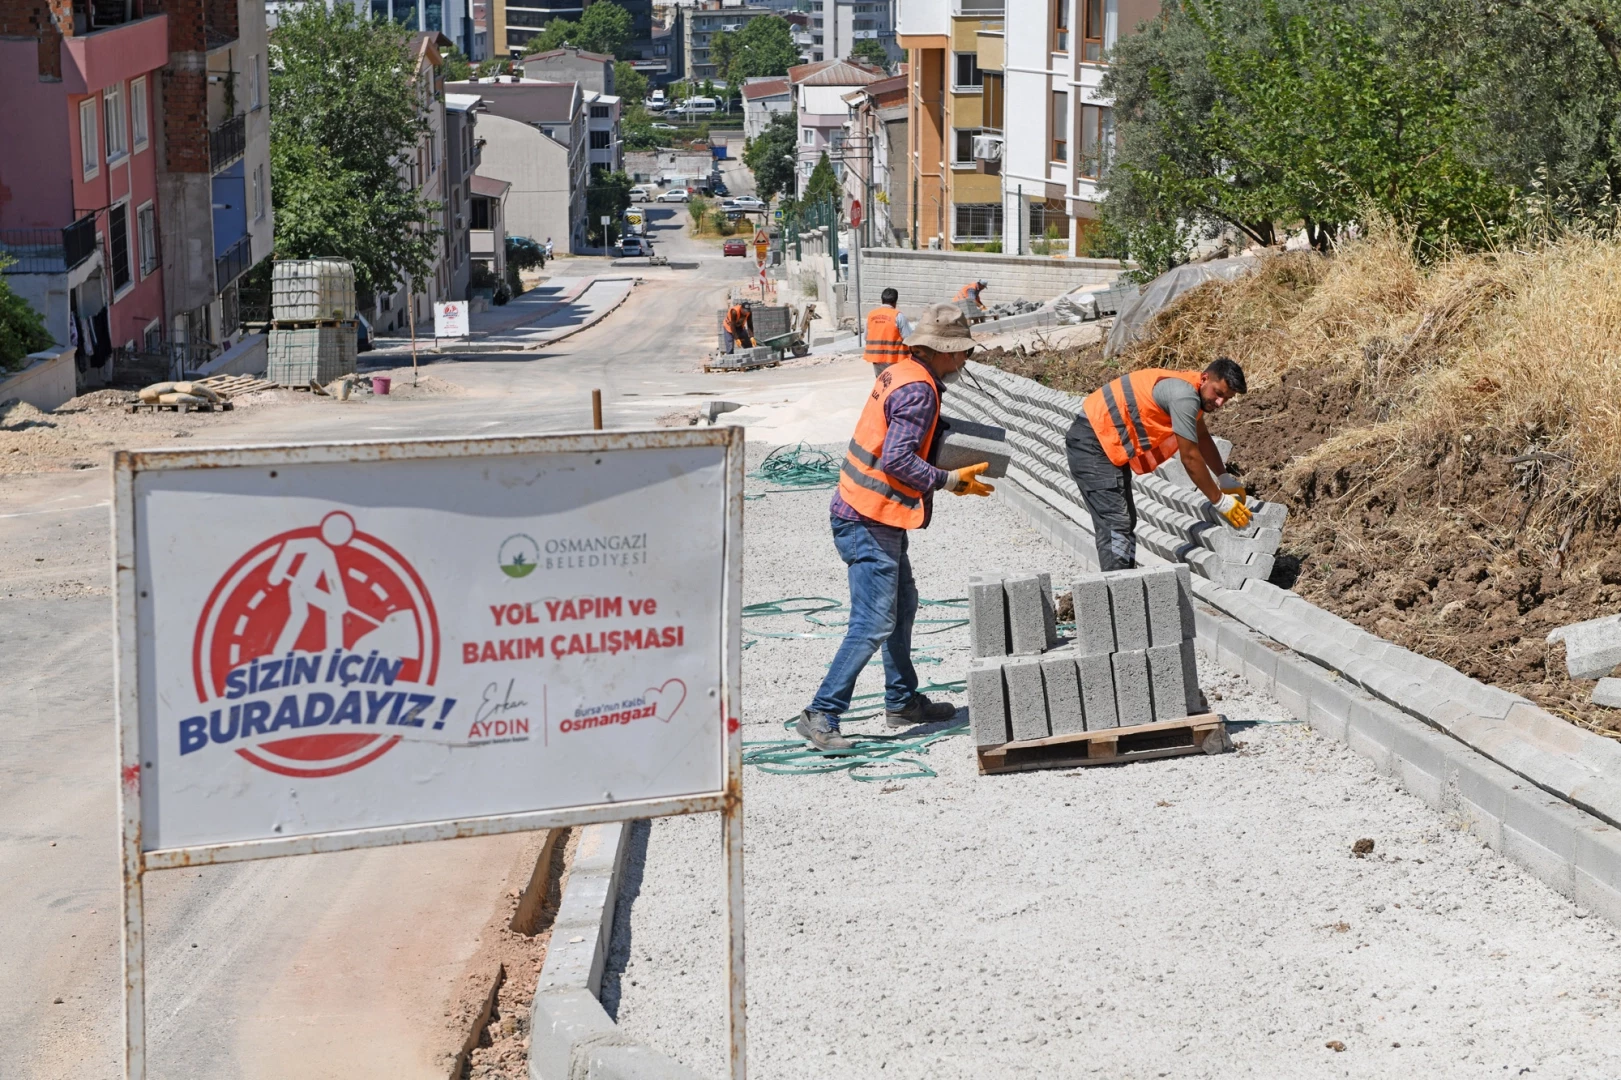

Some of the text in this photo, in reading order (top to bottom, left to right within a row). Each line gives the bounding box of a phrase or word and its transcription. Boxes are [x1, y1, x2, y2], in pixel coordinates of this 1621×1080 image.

[545, 533, 647, 555] OSMANGAZİ
[546, 551, 647, 569] BELEDİYESİ
[489, 596, 657, 626] YOL YAPIM ve
[462, 626, 684, 664] BAKIM ÇALIŞMASI
[225, 648, 404, 700] SİZİN İÇİN
[474, 678, 529, 723] Erkan
[621, 696, 646, 709] Kalbi
[468, 717, 530, 738] AYDIN
[559, 701, 658, 733] Osmangazi
